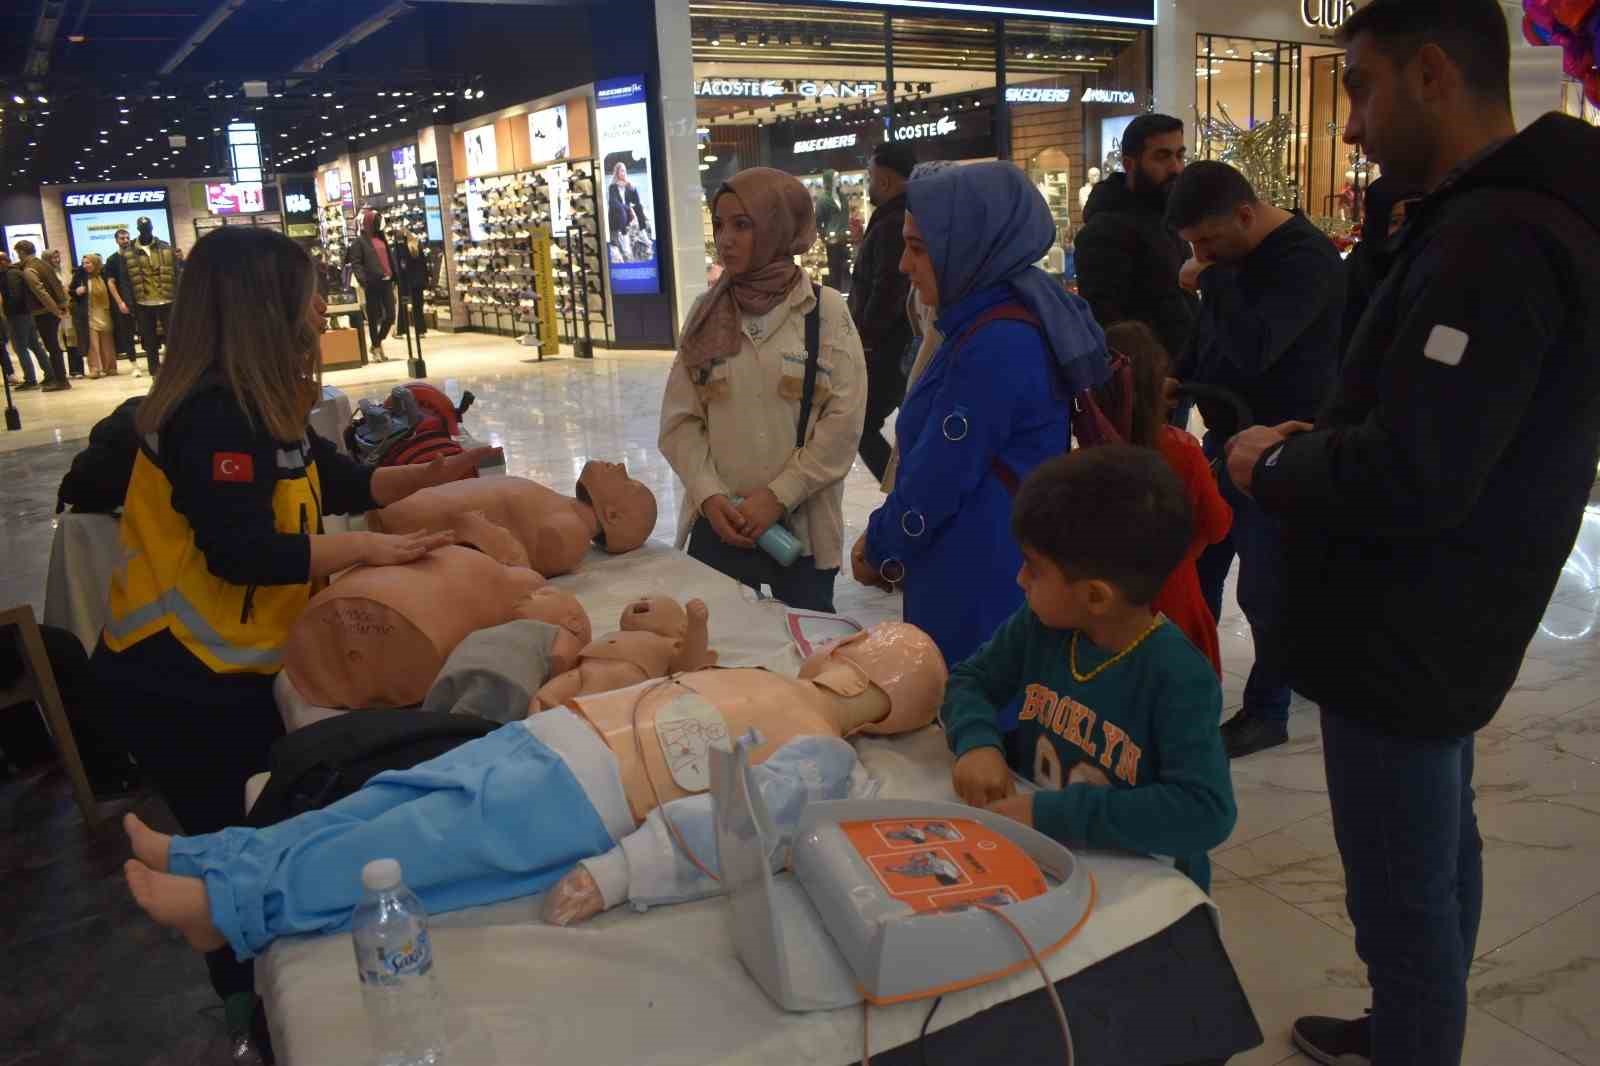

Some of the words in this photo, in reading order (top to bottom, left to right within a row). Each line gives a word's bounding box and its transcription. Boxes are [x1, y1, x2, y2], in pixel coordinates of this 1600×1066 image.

[693, 80, 760, 97] LACOSTE
[800, 82, 876, 98] GANT
[1005, 87, 1071, 103] SKECHERS
[65, 190, 166, 207] SKECHERS
